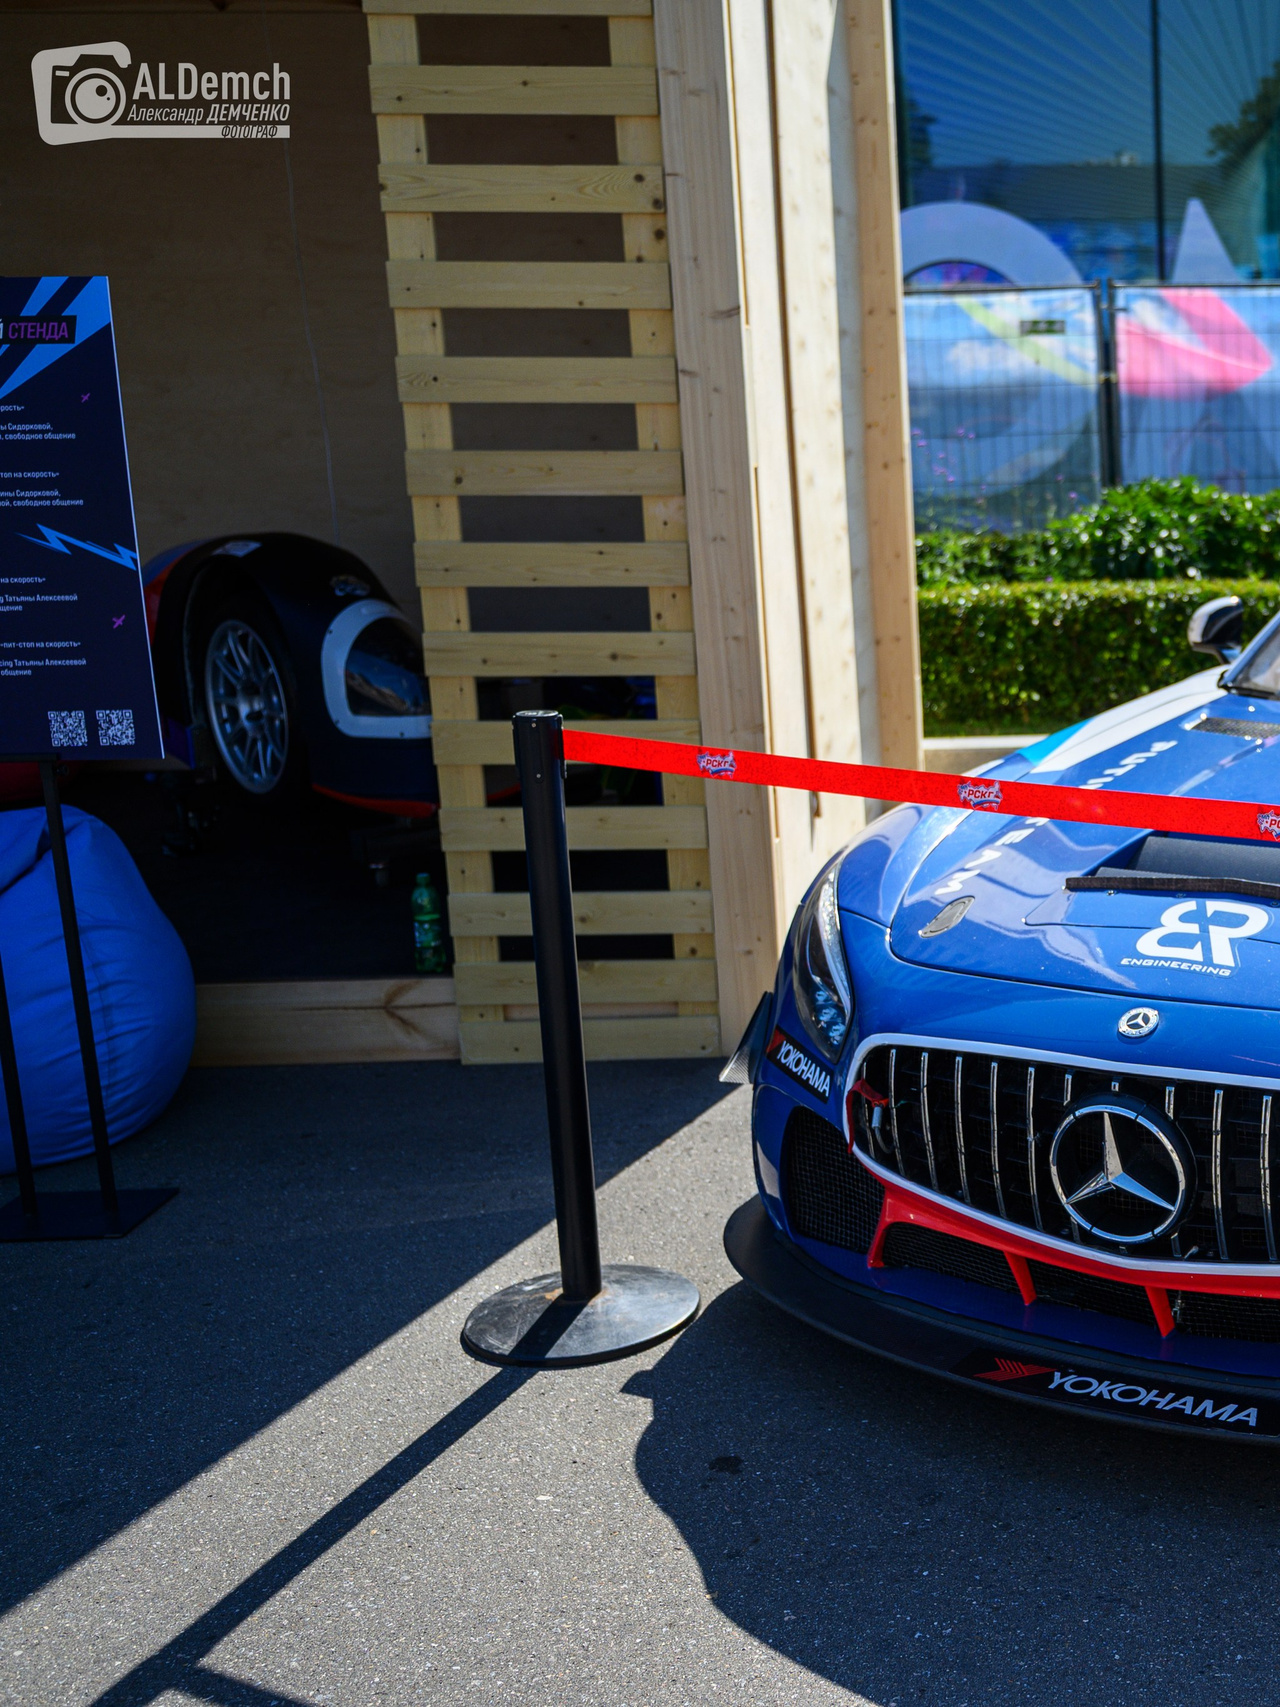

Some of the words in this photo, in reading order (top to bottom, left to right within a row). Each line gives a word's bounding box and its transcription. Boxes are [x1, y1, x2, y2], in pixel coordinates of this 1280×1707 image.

[9, 322, 69, 341] СТЕНДА
[967, 789, 995, 799] РСКГ
[1120, 957, 1232, 977] ENGINEERING
[776, 1040, 831, 1098] YOKOHAMA
[1048, 1371, 1258, 1427] YOKOHAMA
